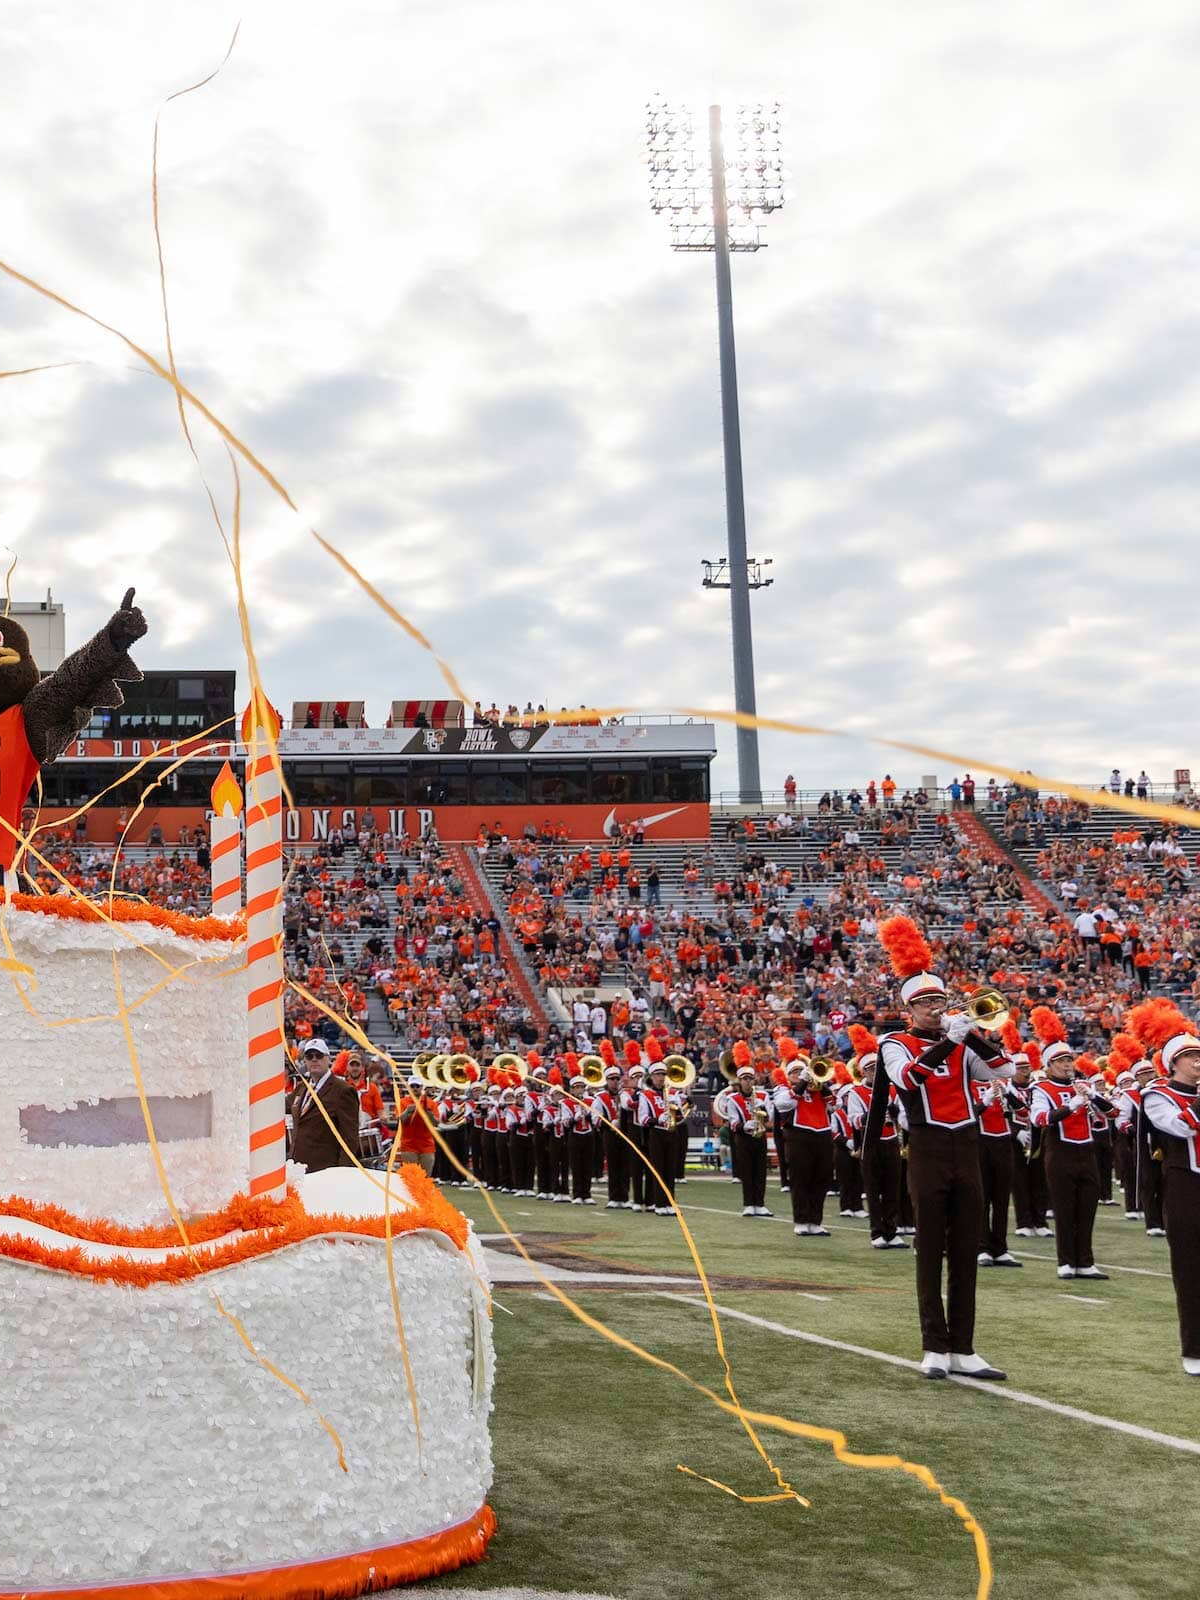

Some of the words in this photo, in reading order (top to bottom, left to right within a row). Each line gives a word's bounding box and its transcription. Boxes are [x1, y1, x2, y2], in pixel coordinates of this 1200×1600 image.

[465, 728, 494, 741] BOWL
[113, 740, 180, 757] DOYT
[459, 740, 498, 751] HISTORY
[388, 809, 434, 841] UP
